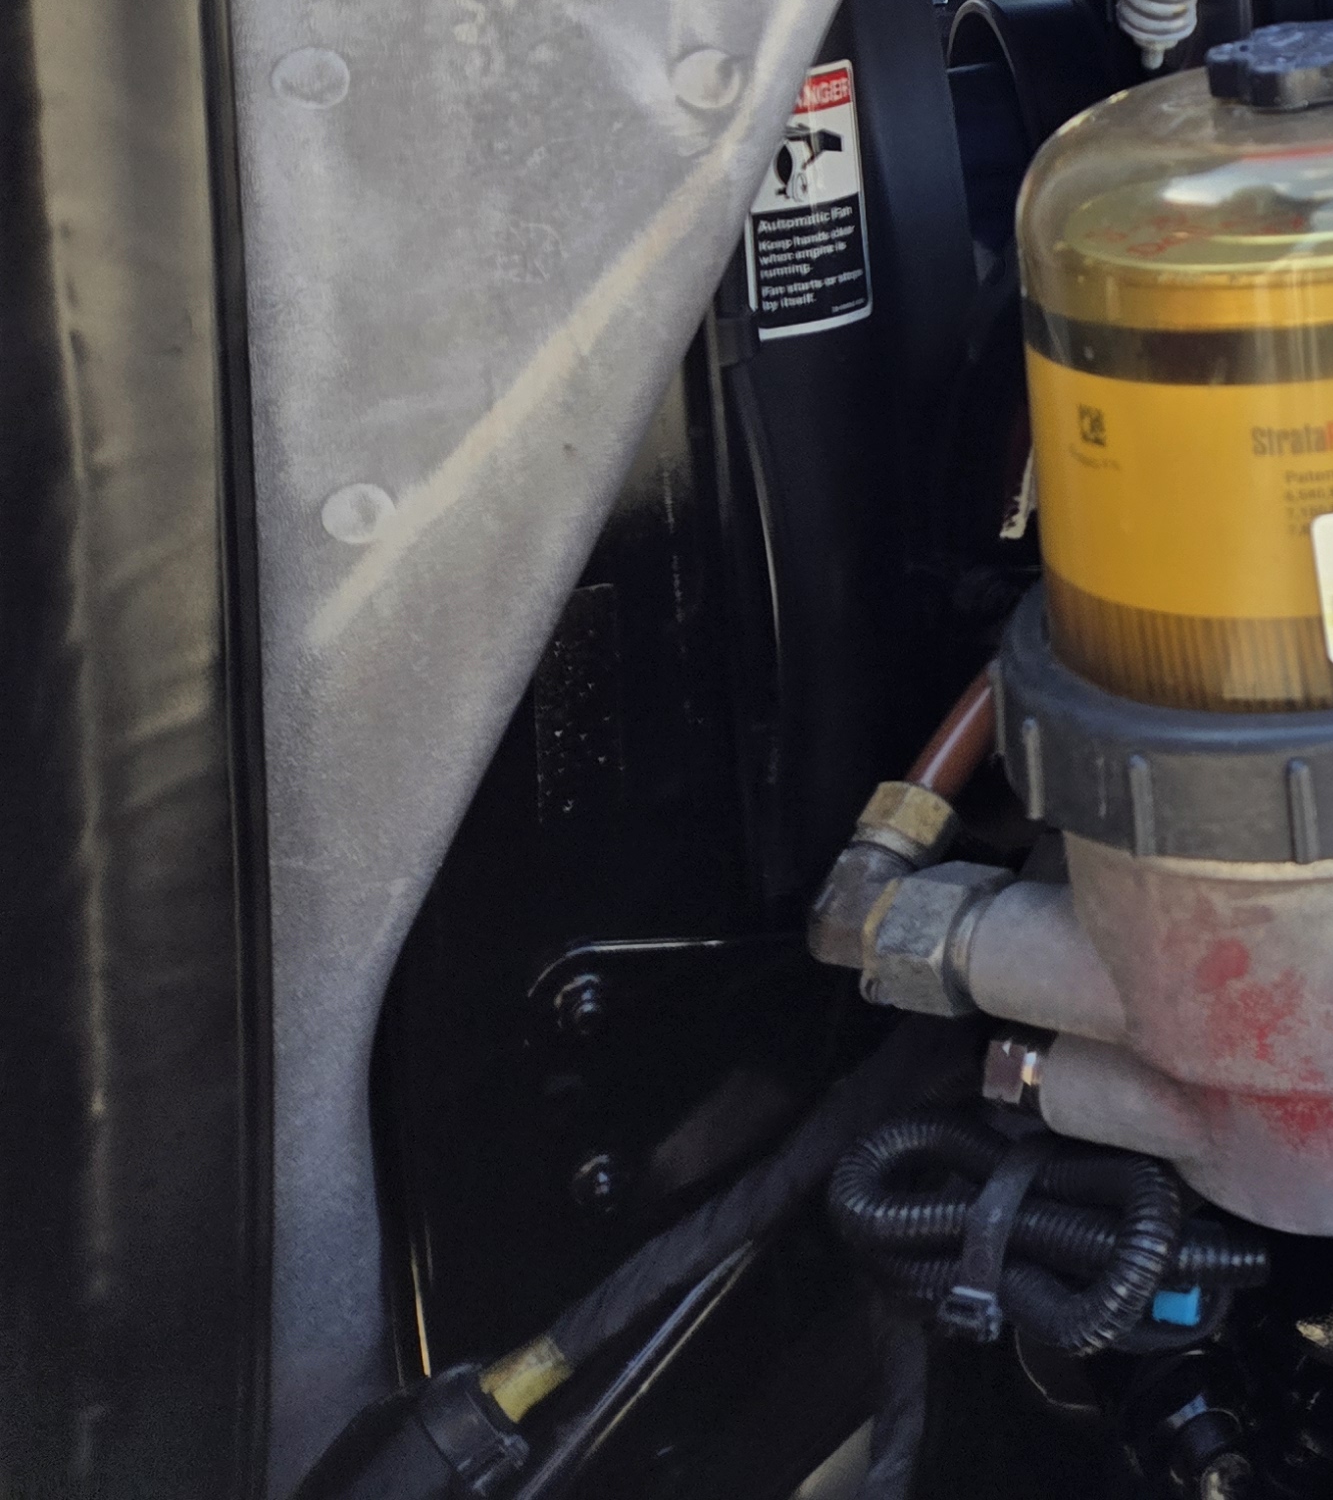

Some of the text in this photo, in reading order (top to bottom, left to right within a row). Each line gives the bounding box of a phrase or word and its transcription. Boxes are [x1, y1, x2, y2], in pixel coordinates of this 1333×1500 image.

[800, 77, 850, 107] ANGER
[757, 205, 853, 235] Automatic Fan
[758, 238, 793, 252] Keep
[792, 231, 830, 248] hands
[759, 251, 795, 266] when
[794, 243, 835, 261] engine
[760, 262, 814, 280] running.
[761, 285, 786, 298] Fan
[786, 279, 824, 295] starts
[762, 299, 779, 313] by
